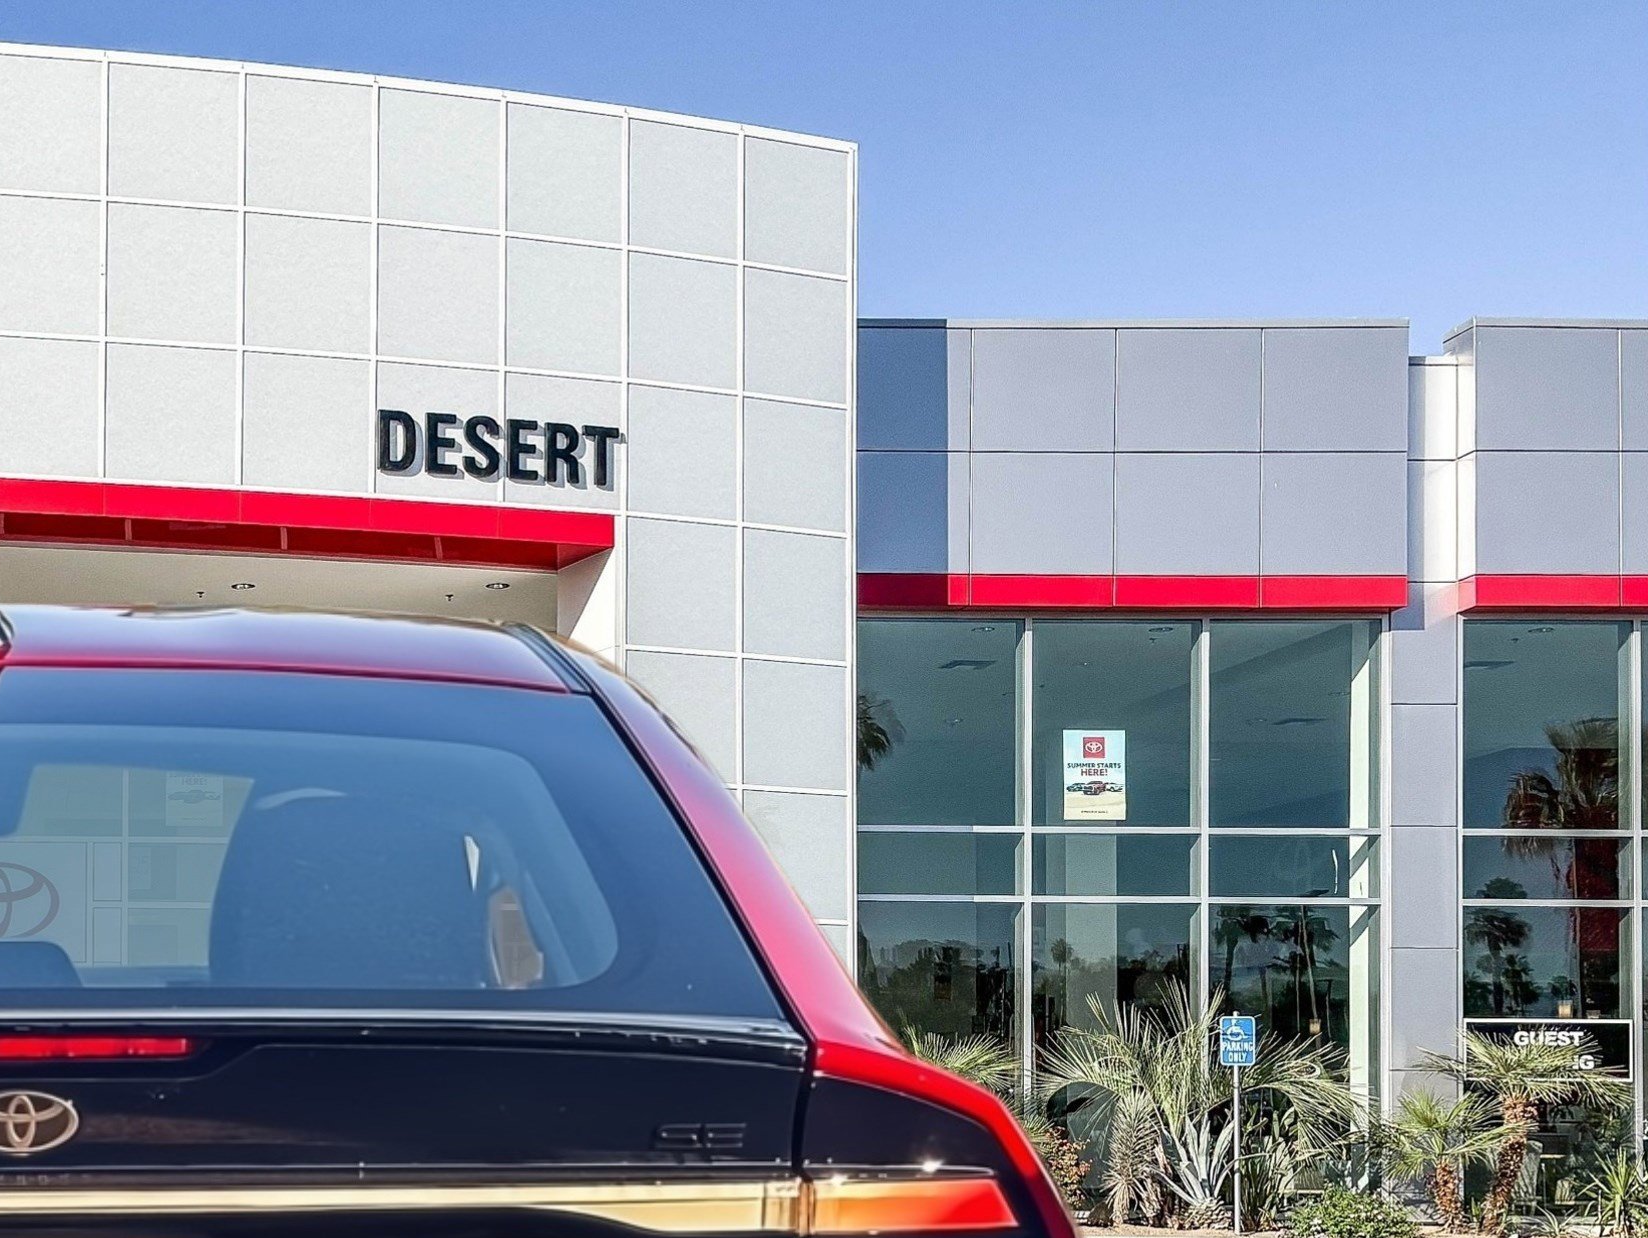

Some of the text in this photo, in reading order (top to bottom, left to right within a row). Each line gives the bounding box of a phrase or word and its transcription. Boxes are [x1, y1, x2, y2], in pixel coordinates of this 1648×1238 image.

[377, 409, 619, 486] DESERT
[1081, 768, 1108, 777] HERE!
[1513, 1030, 1584, 1047] GUEST
[1222, 1041, 1254, 1052] PARKING
[1228, 1052, 1248, 1063] ONLY
[654, 1122, 747, 1149] SE
